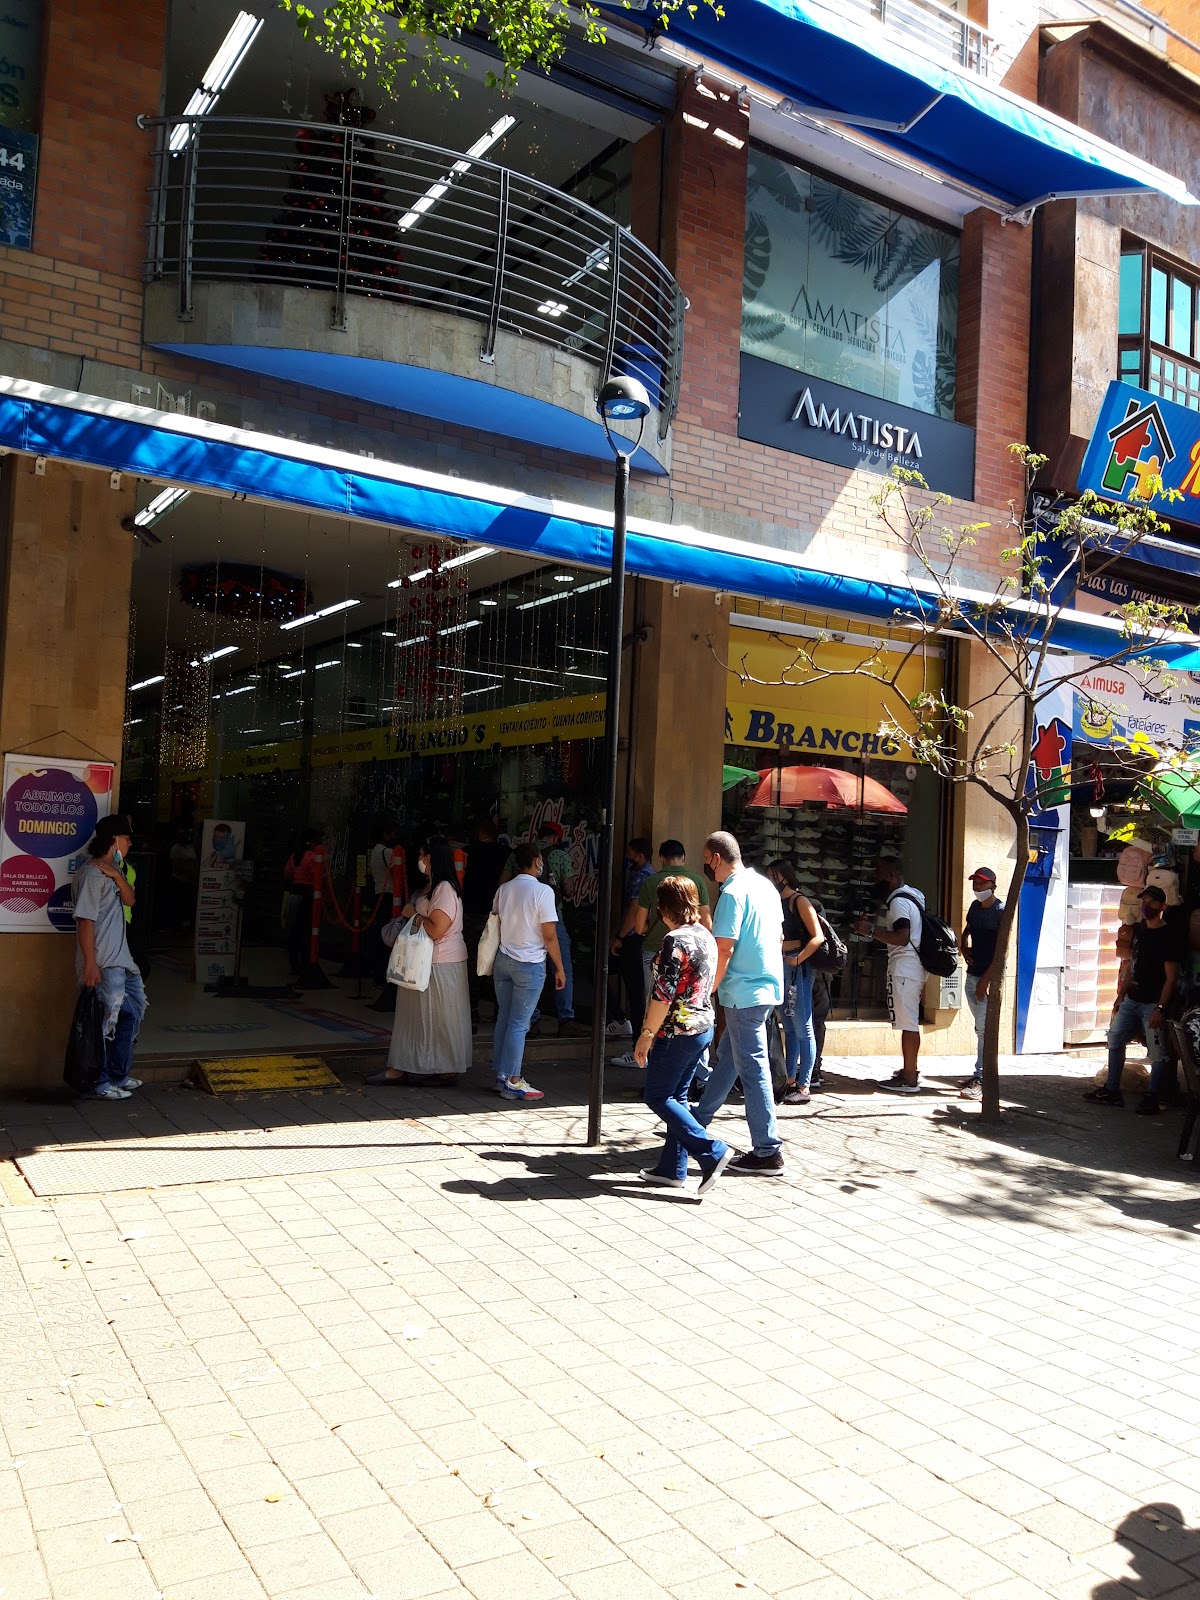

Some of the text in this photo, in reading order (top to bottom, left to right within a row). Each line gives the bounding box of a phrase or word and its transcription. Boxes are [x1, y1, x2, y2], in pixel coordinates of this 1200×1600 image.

[789, 314, 808, 328] CORTE
[812, 321, 843, 342] CEPILLADO
[791, 284, 907, 354] AMATISTA
[790, 386, 923, 458] AMATISTA
[851, 442, 920, 469] Sala de Belleza
[14, 800, 85, 816] TODOS LOS
[21, 789, 82, 804] ABRIMOS
[18, 819, 78, 836] DOMINGOS
